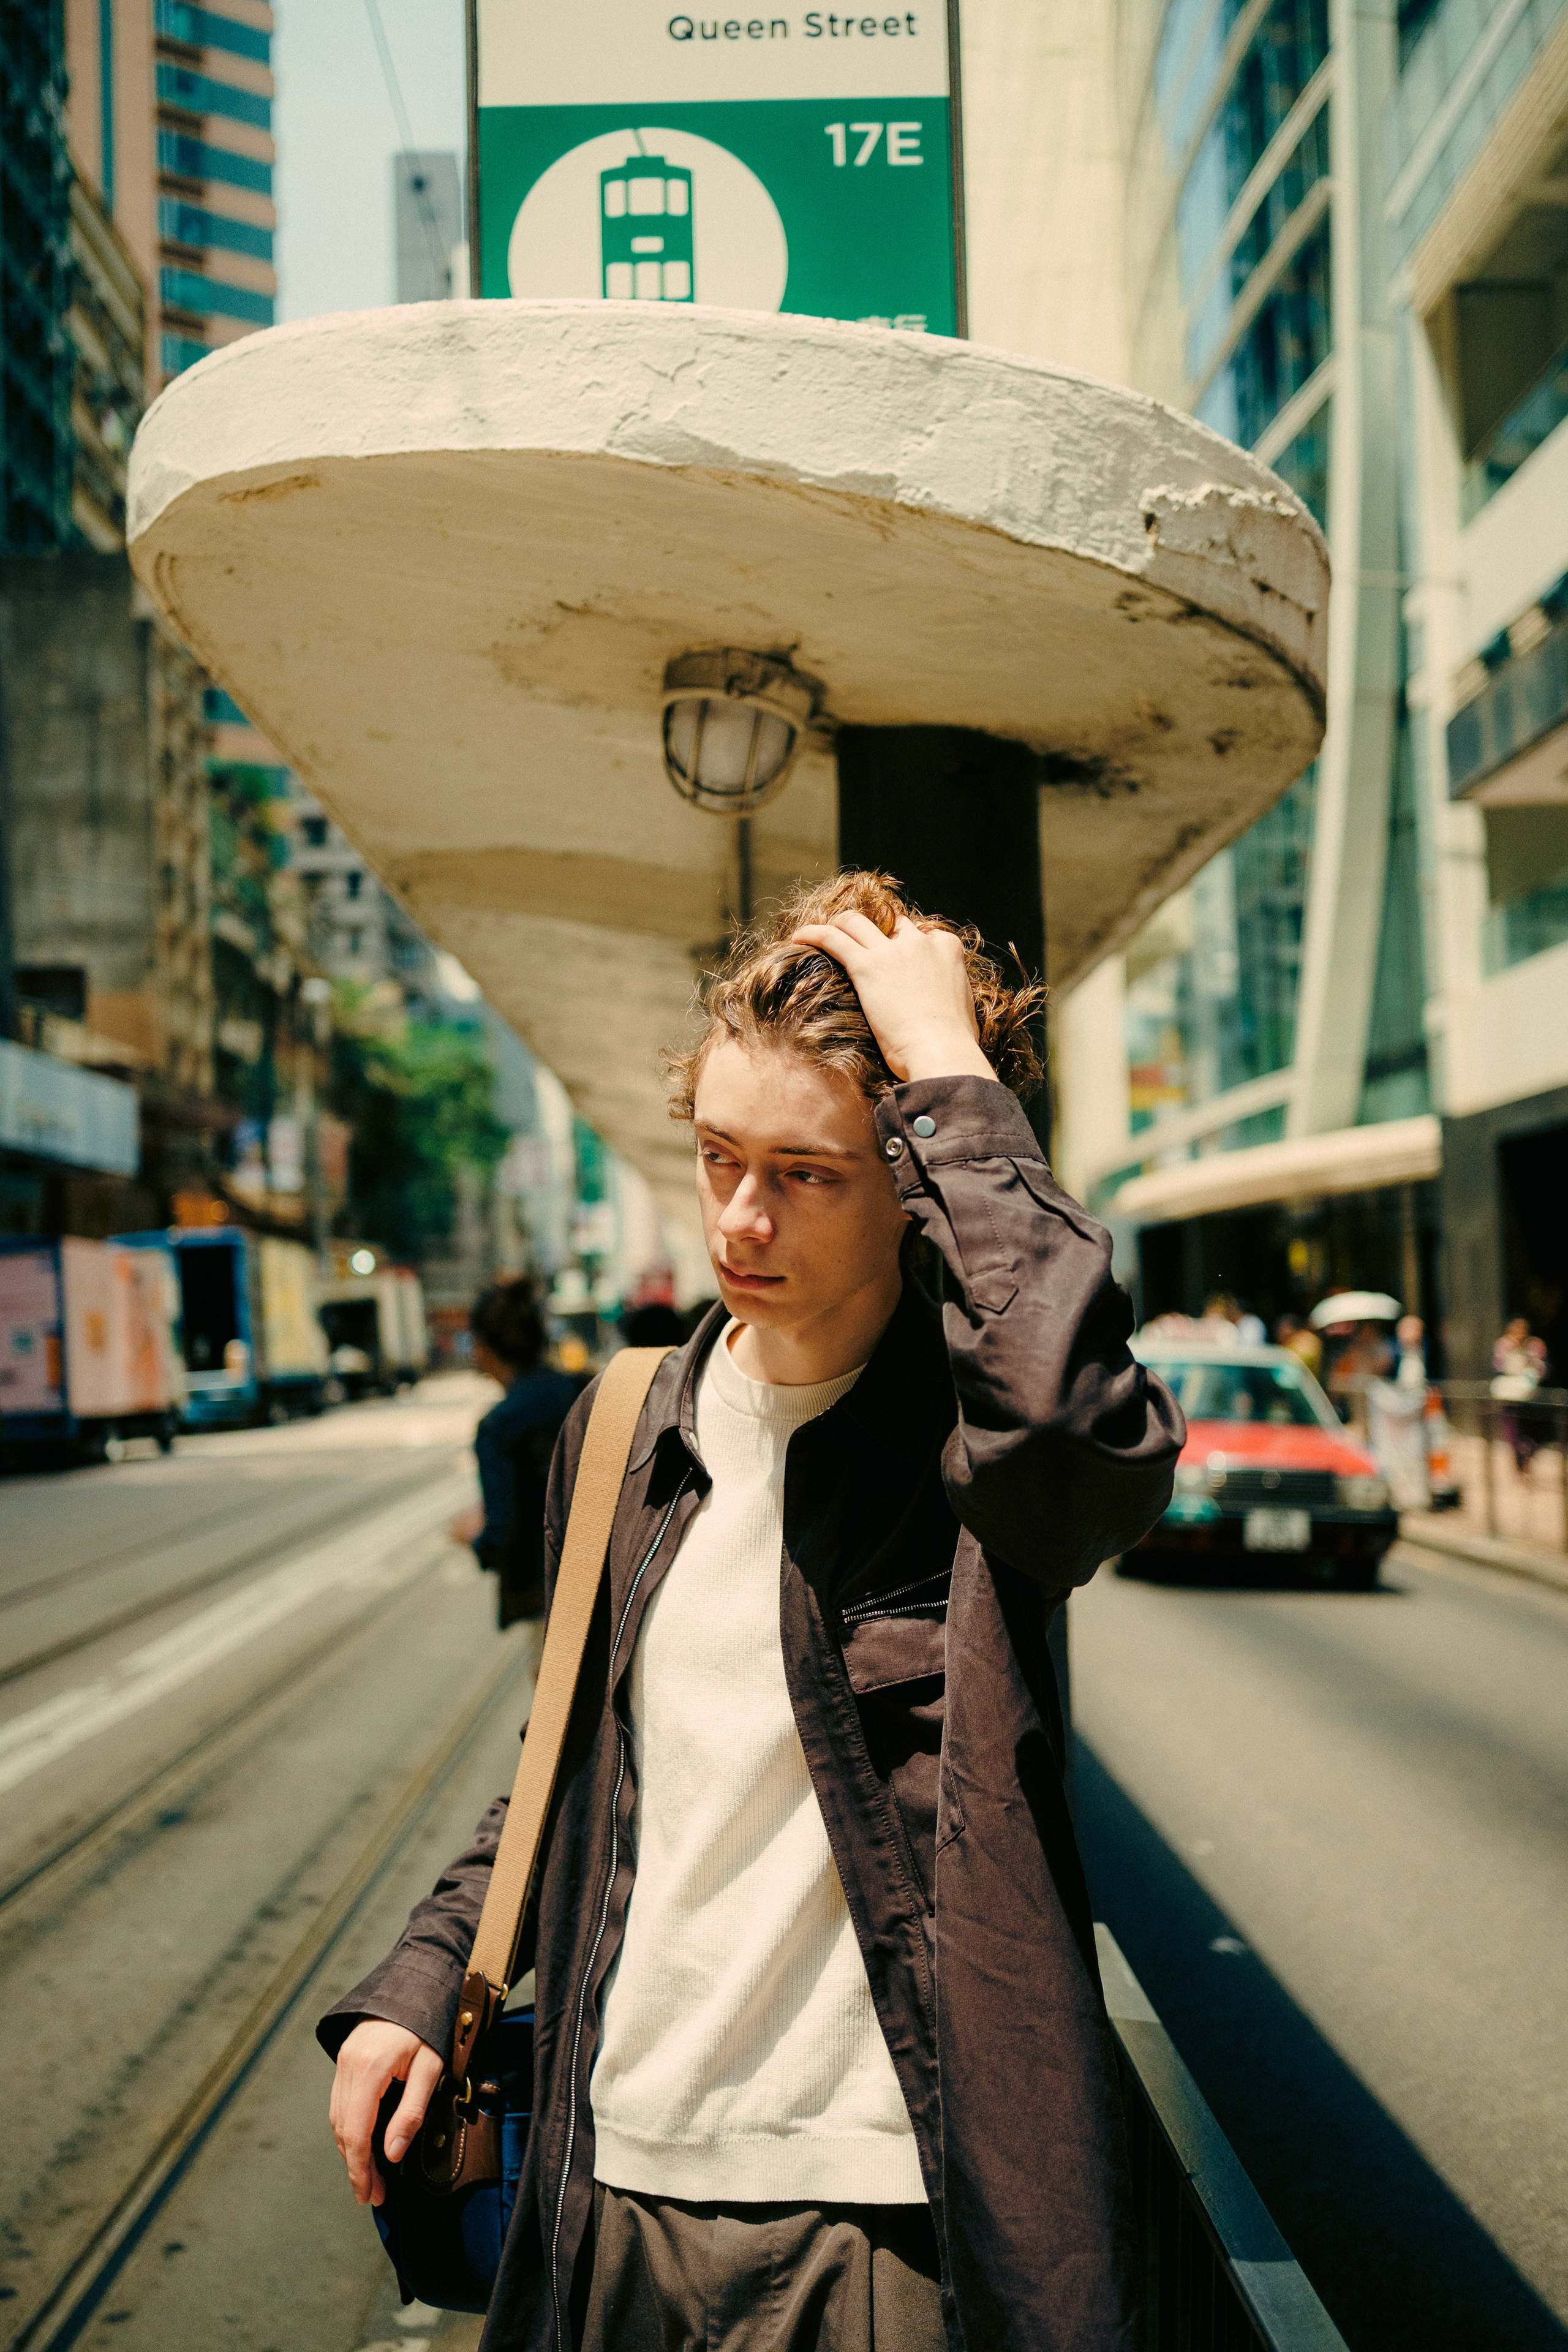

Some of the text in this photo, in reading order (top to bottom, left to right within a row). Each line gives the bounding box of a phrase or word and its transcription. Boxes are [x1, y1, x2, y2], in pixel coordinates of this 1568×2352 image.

[669, 11, 916, 40] Queen Street
[824, 122, 924, 167] 17E
